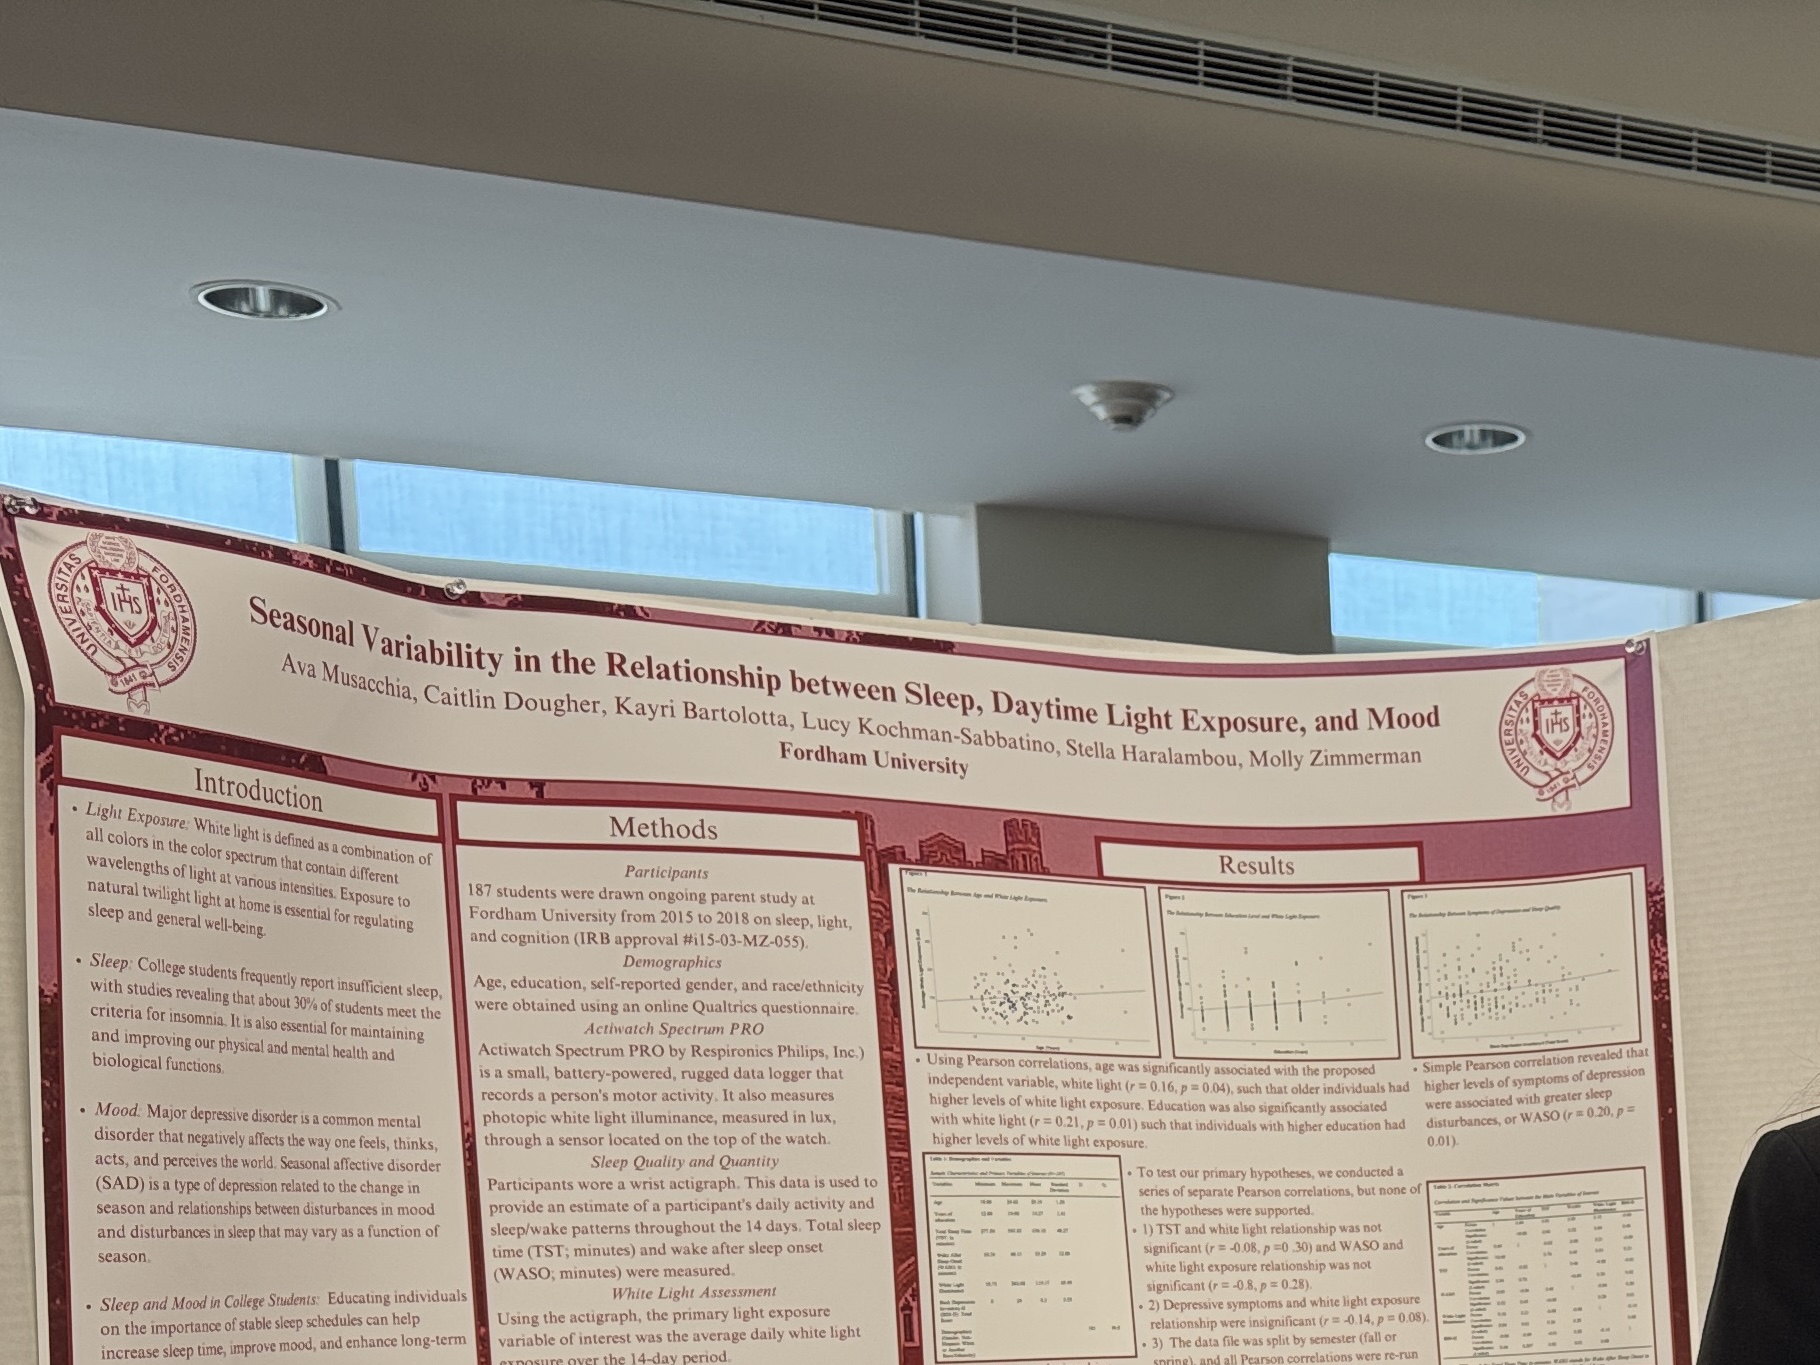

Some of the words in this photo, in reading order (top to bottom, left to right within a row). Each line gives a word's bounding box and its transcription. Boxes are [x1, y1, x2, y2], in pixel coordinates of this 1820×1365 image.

[55, 553, 97, 656] UNIVERSITAS
[111, 584, 142, 614] IHS
[151, 565, 190, 672] FORDHAMENSIS
[249, 596, 354, 647] Seasonal
[361, 624, 504, 678] Variability
[514, 647, 541, 674] in
[551, 648, 596, 675] the
[605, 652, 781, 697] Relationship
[789, 669, 897, 702] between
[904, 681, 983, 716] Sleep,
[991, 690, 1098, 724] Daytime
[1106, 703, 1173, 735] Light
[1181, 708, 1306, 738] Exposure,
[1315, 708, 1359, 732] and
[1367, 705, 1440, 730] Mood
[281, 653, 316, 678] Ava
[322, 661, 418, 704] Musacchia,
[424, 684, 496, 710] Caitlin
[503, 691, 607, 717] Dougher,
[614, 696, 676, 722] Kayri
[682, 701, 794, 730] Bartolotta,
[801, 711, 850, 738] Lucy
[858, 717, 1060, 756] Kochman-Sabbatino,
[1066, 738, 1116, 760] Stella
[1122, 744, 1243, 768] Haralambou,
[1249, 750, 1304, 772] Molly
[1310, 749, 1422, 766] Zimmerman
[1545, 709, 1570, 734] IHS
[1504, 691, 1530, 776] UNIVERSITAS
[1582, 686, 1609, 771] FORDHAMENSIS
[779, 741, 867, 766] Fordham
[873, 750, 968, 780] University
[194, 767, 323, 812] Introduction
[85, 801, 122, 822] Light
[194, 816, 230, 836] White
[233, 823, 260, 843] light
[262, 832, 272, 843] is
[274, 831, 315, 850] defined
[318, 841, 330, 852] as
[332, 844, 338, 854] a
[341, 844, 415, 864] combination
[418, 852, 433, 866] of
[609, 816, 718, 840] Methods
[624, 864, 709, 882] Participants
[1219, 855, 1295, 875] Results
[469, 905, 537, 921] Fordham
[541, 908, 616, 926] University
[621, 909, 656, 923] from
[660, 910, 693, 924] 2015
[697, 913, 712, 924] to
[716, 911, 750, 925] 2018
[753, 916, 772, 926] on
[775, 913, 814, 930] sleep,
[817, 915, 852, 931] light,
[622, 954, 722, 972] Demographics
[584, 1022, 654, 1035] Actiwatch
[659, 1022, 724, 1038] Spectrum
[730, 1022, 764, 1036] PRO
[92, 1052, 162, 1072] biological
[166, 1056, 225, 1074] functions.
[926, 1052, 964, 1069] Using
[967, 1054, 1016, 1068] Pearson
[1018, 1057, 1092, 1072] correlations,
[1095, 1062, 1114, 1074] age
[1117, 1063, 1140, 1073] was
[1142, 1062, 1211, 1078] significantly
[1214, 1064, 1271, 1076] associated
[1274, 1064, 1299, 1076] with
[1302, 1064, 1320, 1076] the
[1322, 1064, 1376, 1079] proposed
[1422, 1060, 1462, 1075] Simple
[1465, 1060, 1510, 1072] Pearson
[1513, 1054, 1574, 1069] correlation
[1577, 1048, 1623, 1064] revealed
[1626, 1046, 1649, 1058] that
[590, 1155, 628, 1172] Sleep
[633, 1155, 685, 1171] Quality
[689, 1154, 715, 1168] and
[719, 1154, 779, 1171] Quantity
[1136, 1166, 1154, 1178] To
[1156, 1168, 1177, 1178] test
[1179, 1170, 1200, 1178] our
[1202, 1167, 1247, 1182] primary
[1250, 1167, 1315, 1182] hypotheses,
[1317, 1170, 1333, 1178] we
[1335, 1165, 1394, 1178] conducted
[1396, 1168, 1404, 1176] a
[100, 1296, 139, 1315] Sleep
[142, 1296, 168, 1311] and
[171, 1295, 208, 1310] Mood
[210, 1296, 220, 1309] in
[224, 1294, 265, 1311] College
[328, 1291, 391, 1307] Educating
[394, 1289, 468, 1304] individuals
[612, 1286, 653, 1300] White
[658, 1286, 694, 1302] Light
[699, 1286, 776, 1298] Assessment
